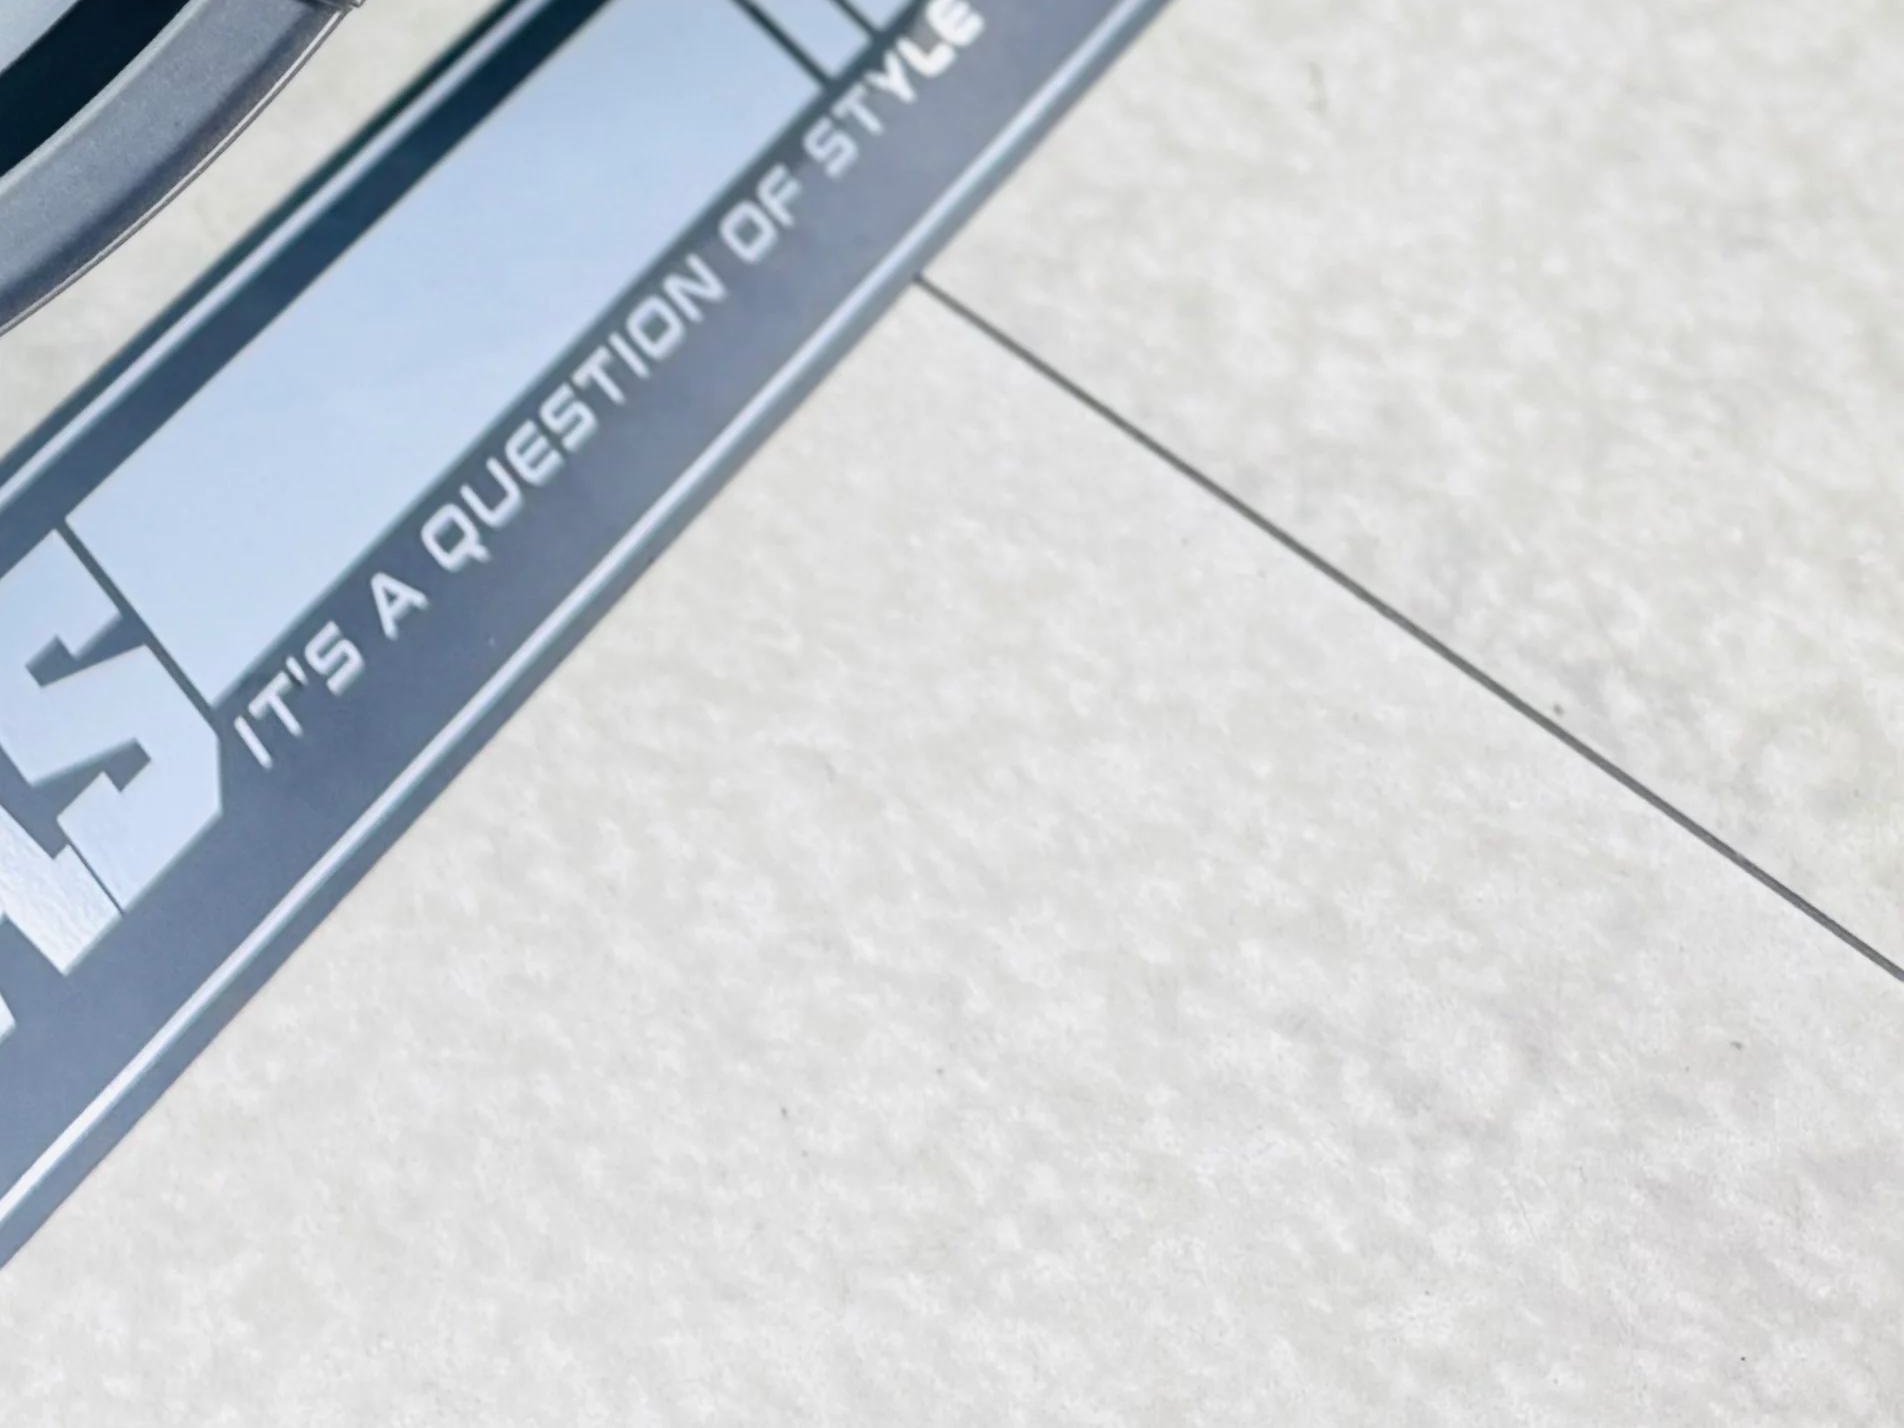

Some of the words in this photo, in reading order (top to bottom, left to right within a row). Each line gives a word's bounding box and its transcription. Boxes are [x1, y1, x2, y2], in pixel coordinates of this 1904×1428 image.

[233, 621, 365, 769] IT'S
[370, 570, 430, 639] A
[420, 252, 728, 573] QUESTION
[718, 163, 803, 264] OF
